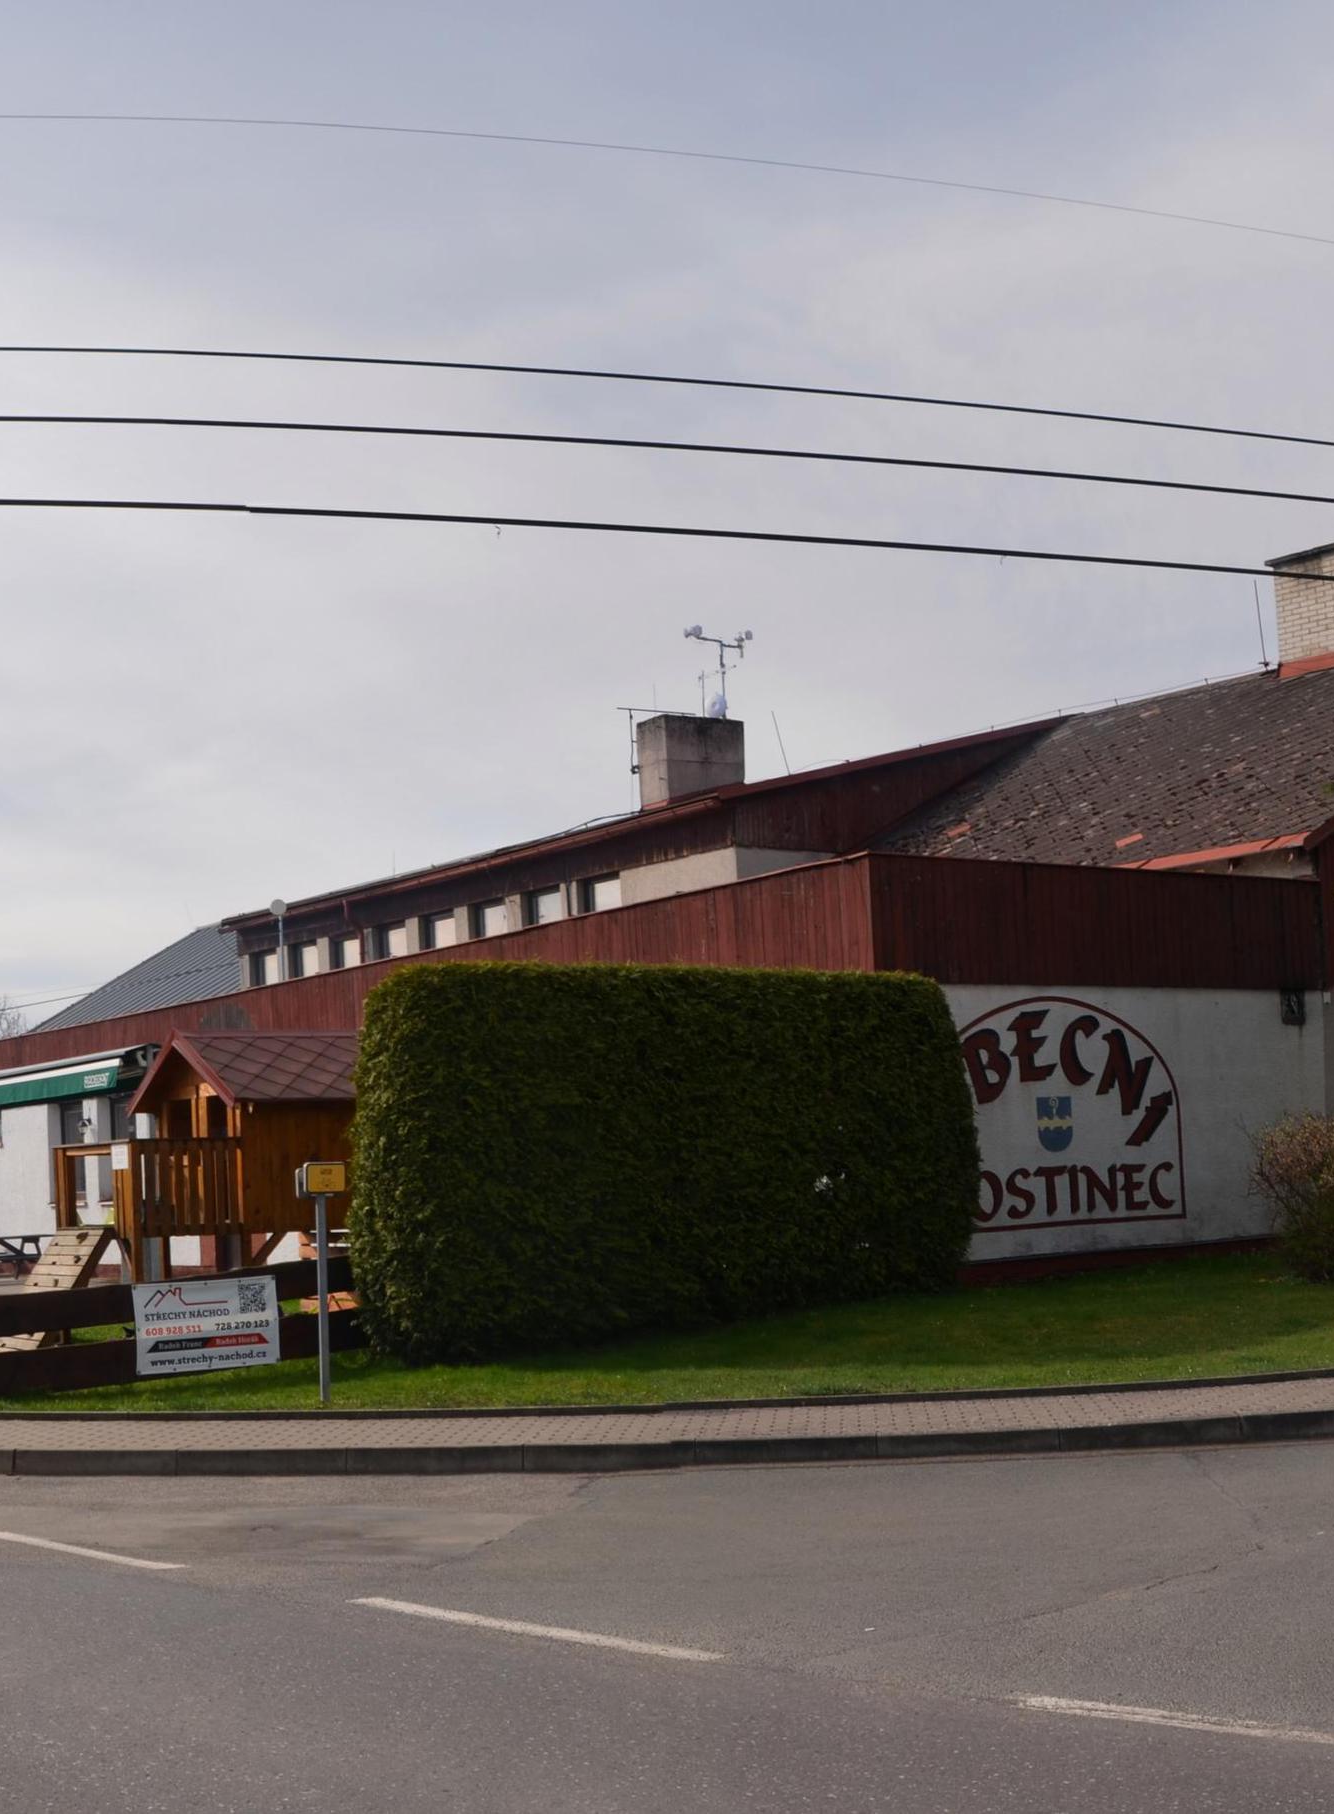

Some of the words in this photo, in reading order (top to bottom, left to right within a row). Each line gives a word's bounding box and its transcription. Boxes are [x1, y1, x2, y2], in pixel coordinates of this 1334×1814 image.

[961, 1008, 1173, 1147] BECNÍ
[972, 1160, 1176, 1223] OSTINEC
[144, 1312, 187, 1322] STŘECHY
[189, 1309, 230, 1319] NÁCHOD
[145, 1326, 164, 1337] 608
[166, 1325, 184, 1335] 928
[186, 1324, 203, 1334] 511
[215, 1322, 232, 1331] 728
[234, 1320, 251, 1330] 270
[254, 1319, 270, 1329] 123
[151, 1350, 266, 1365] www.strechy-nachod.cz
